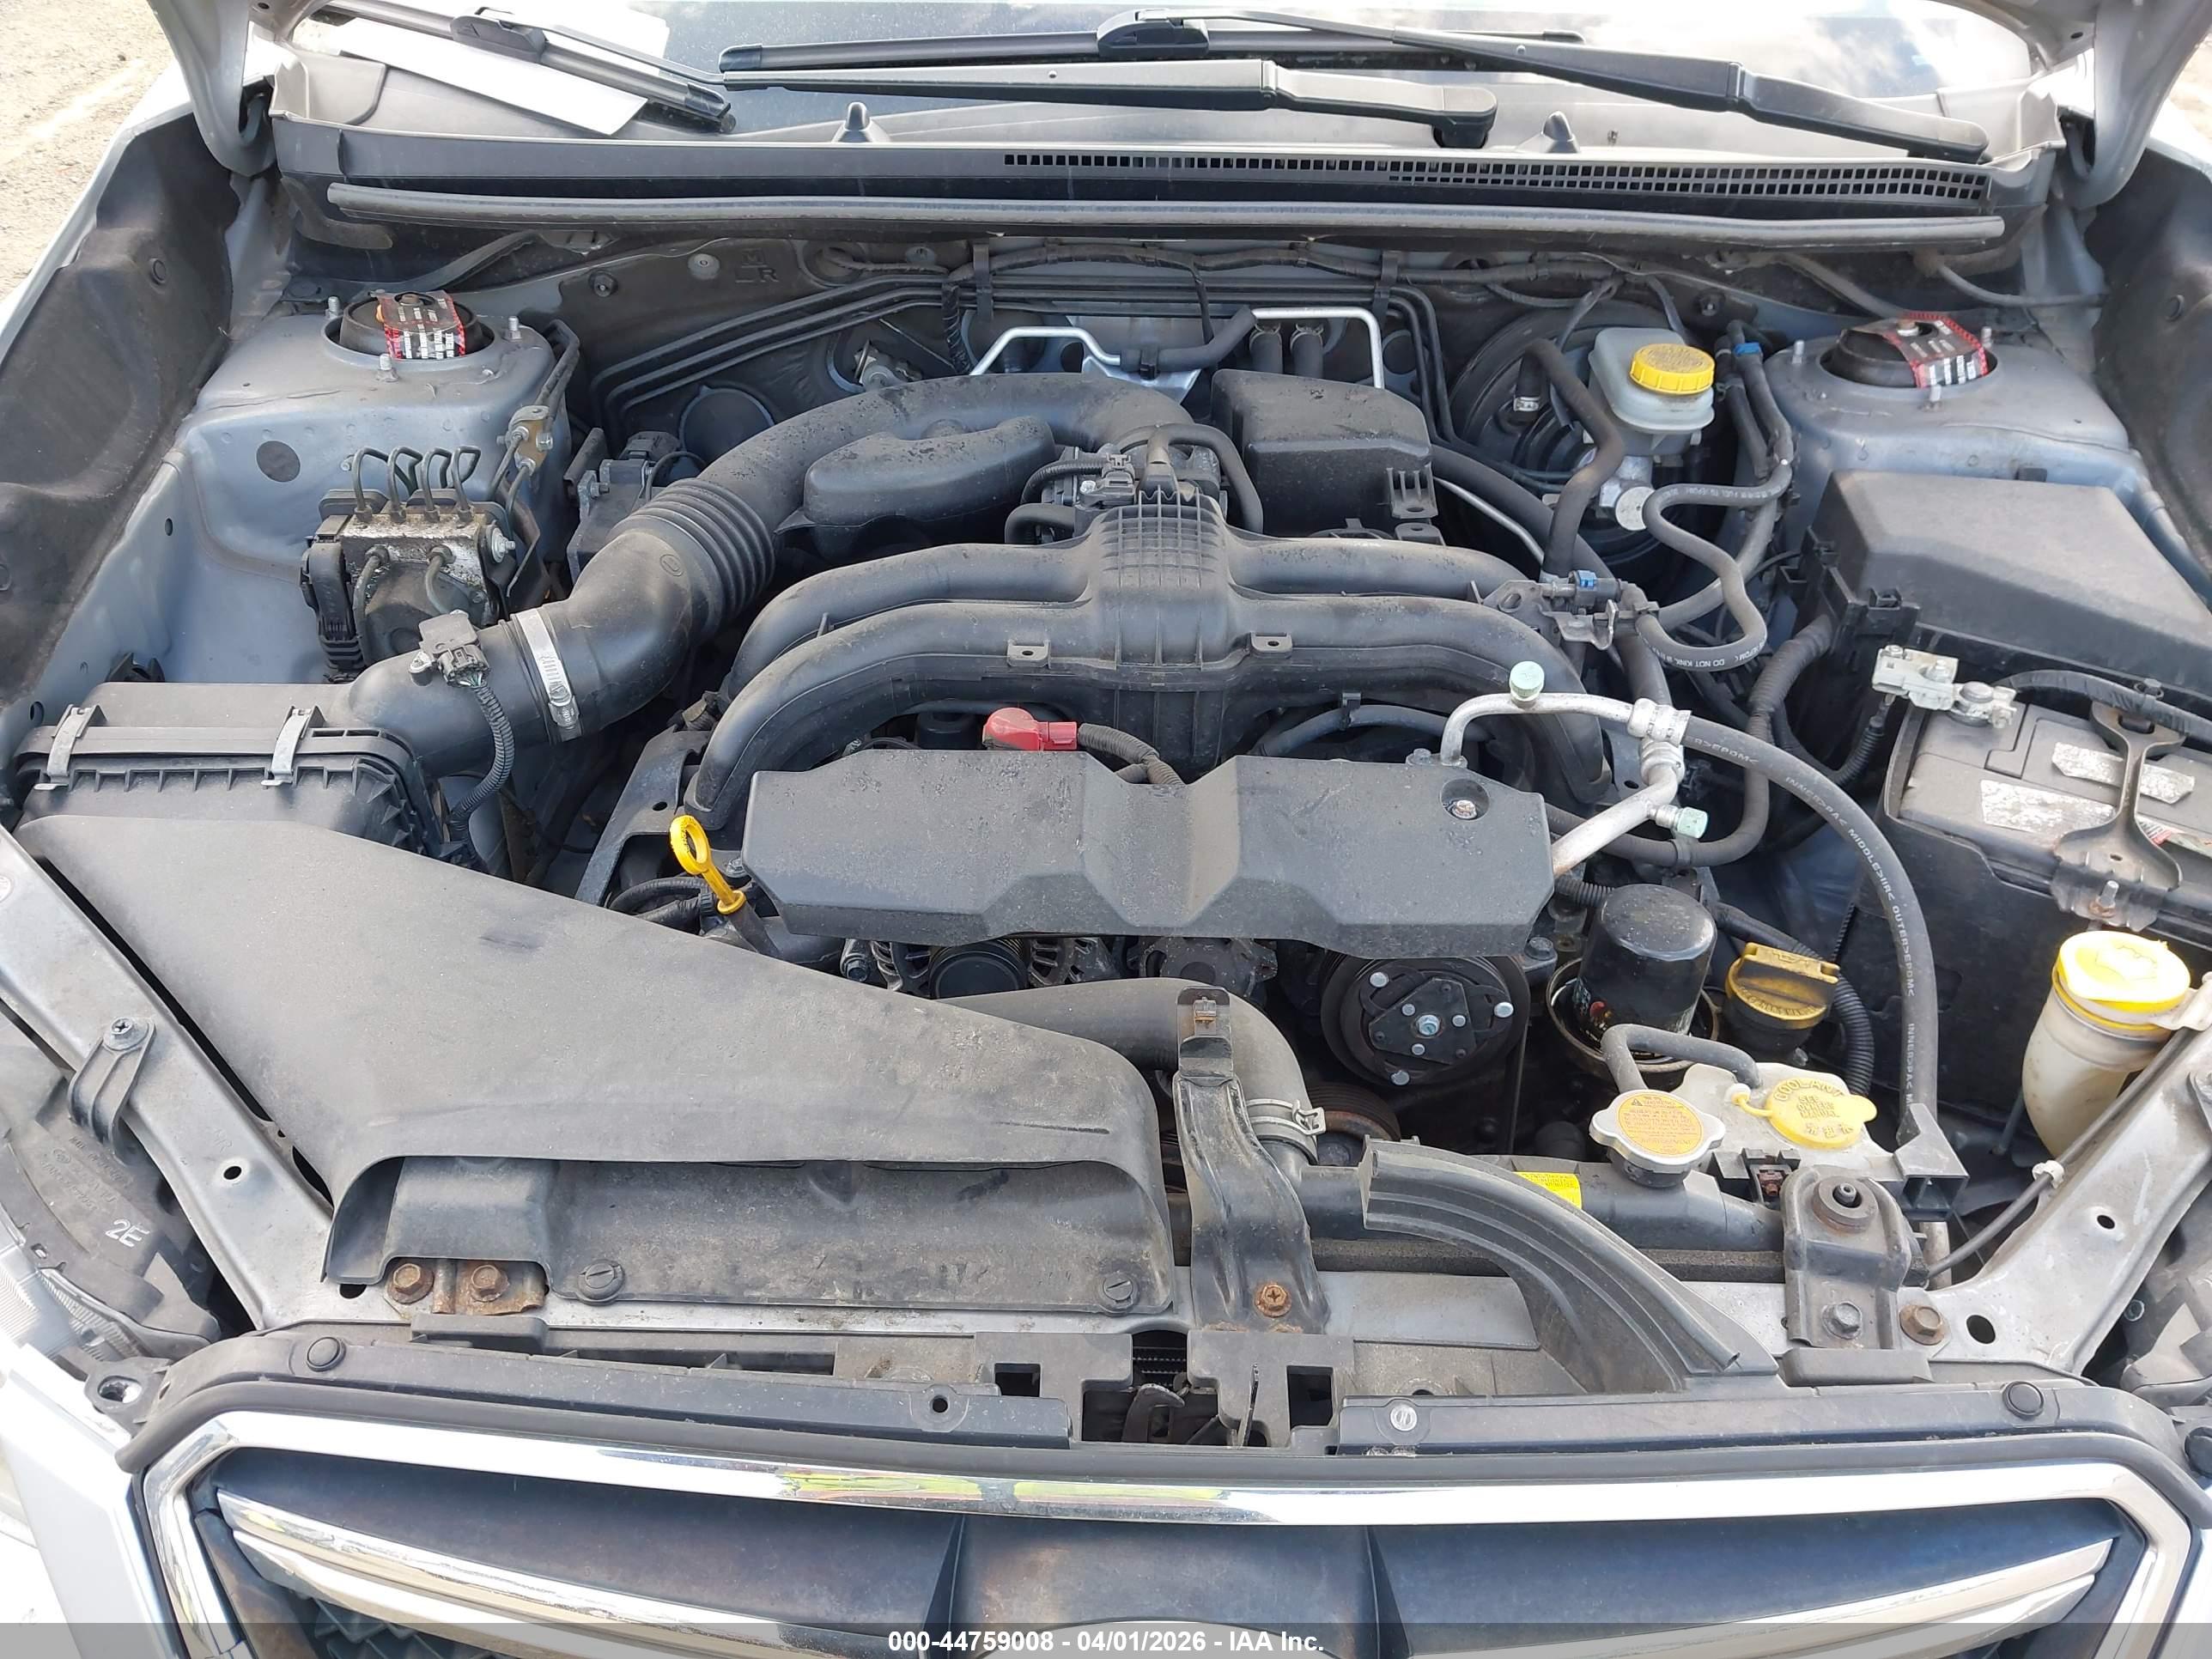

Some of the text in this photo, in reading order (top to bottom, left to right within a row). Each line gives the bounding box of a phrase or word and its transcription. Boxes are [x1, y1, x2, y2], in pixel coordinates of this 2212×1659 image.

[1694, 659, 1711, 667] NOT
[1772, 1079, 1844, 1101] COOLANT
[106, 1218, 150, 1248] 2E
